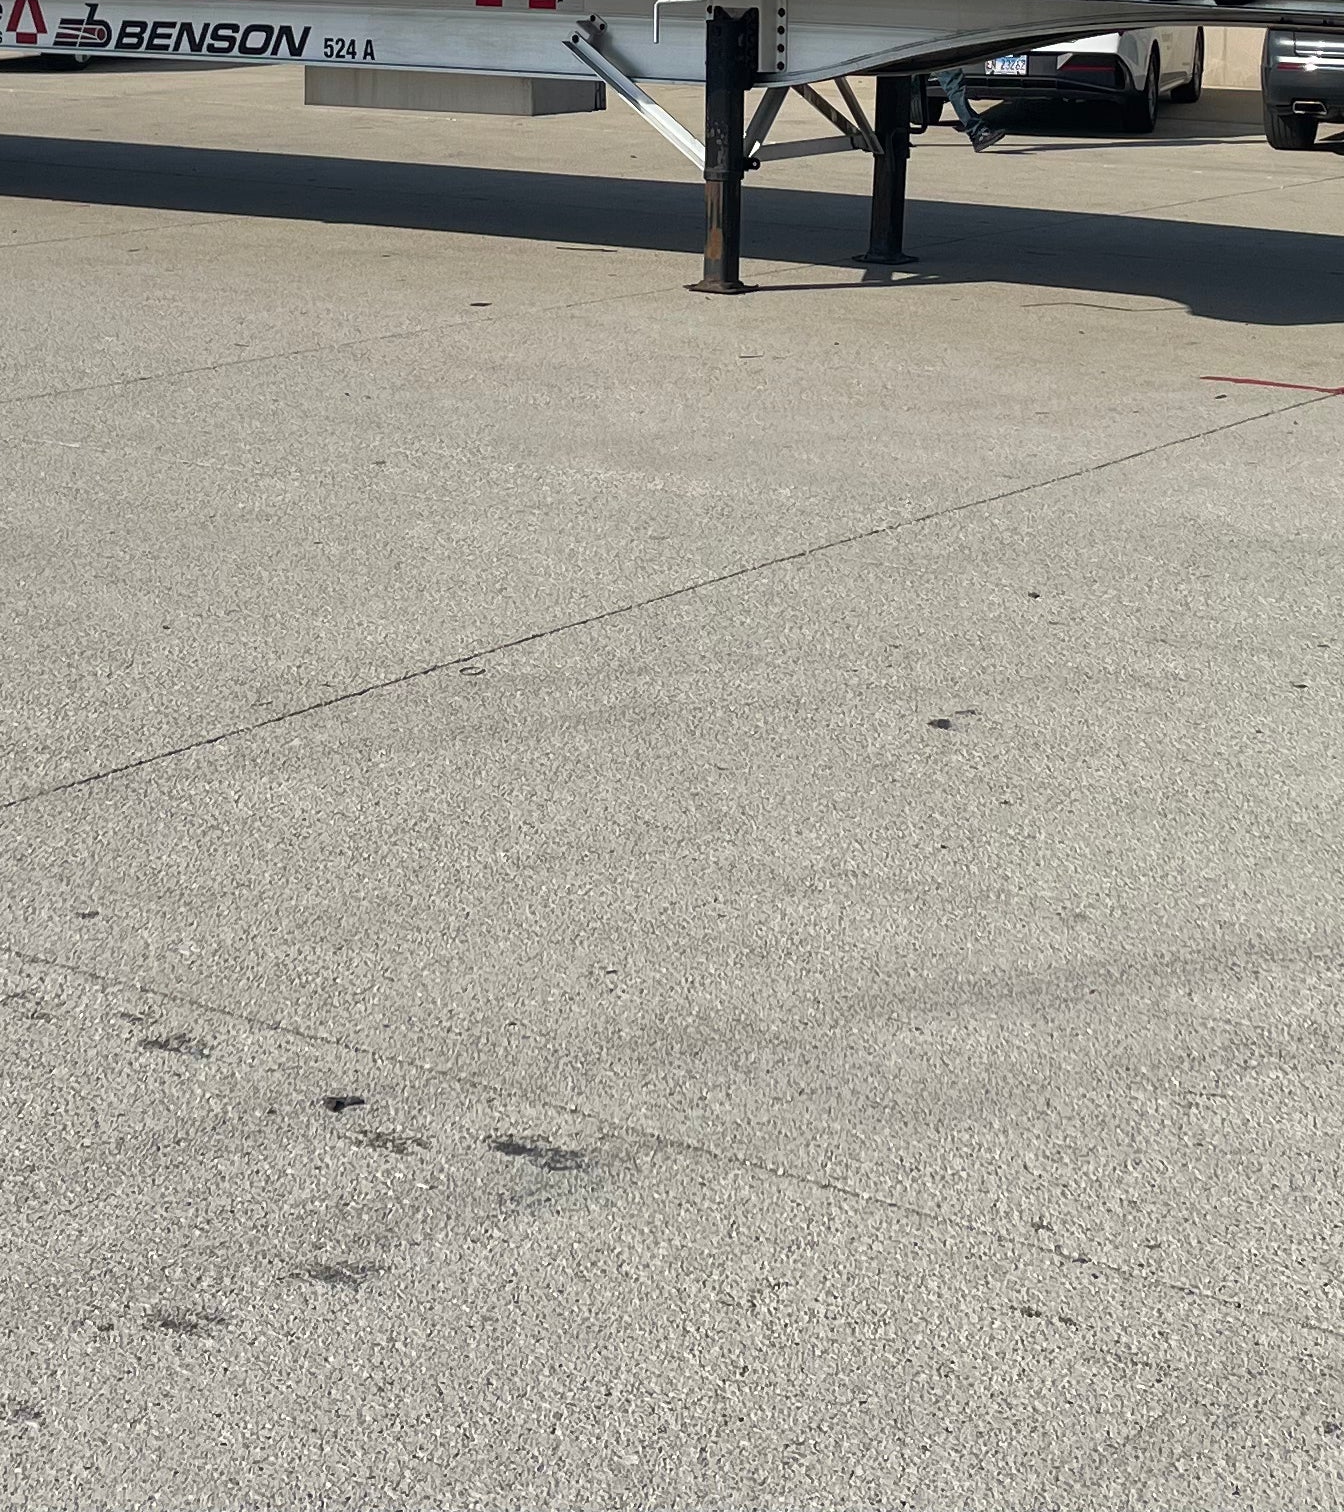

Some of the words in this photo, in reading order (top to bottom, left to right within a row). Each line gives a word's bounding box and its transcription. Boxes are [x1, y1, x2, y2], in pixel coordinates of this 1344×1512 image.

[114, 19, 312, 57] BENSON
[323, 37, 357, 60] 524
[362, 39, 376, 61] A
